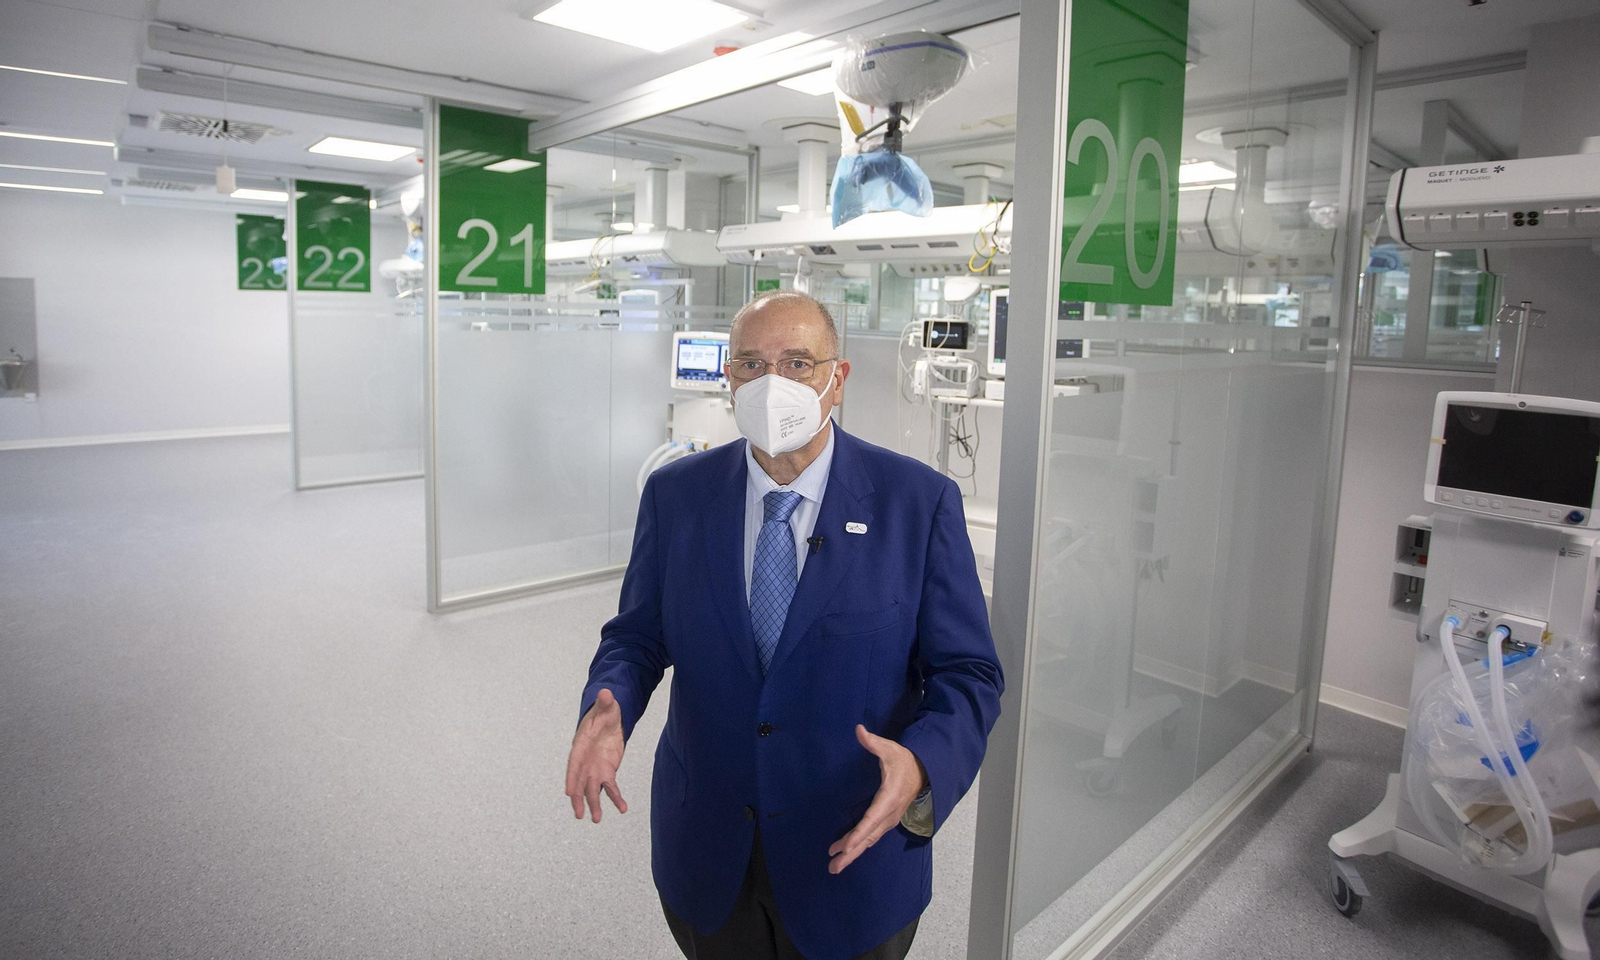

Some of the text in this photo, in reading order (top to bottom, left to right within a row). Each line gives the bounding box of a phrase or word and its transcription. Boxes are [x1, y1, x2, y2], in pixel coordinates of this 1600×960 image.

[1428, 167, 1489, 178] GETINGE
[1060, 118, 1169, 289] 20
[303, 245, 365, 289] 22
[455, 218, 534, 288] 21
